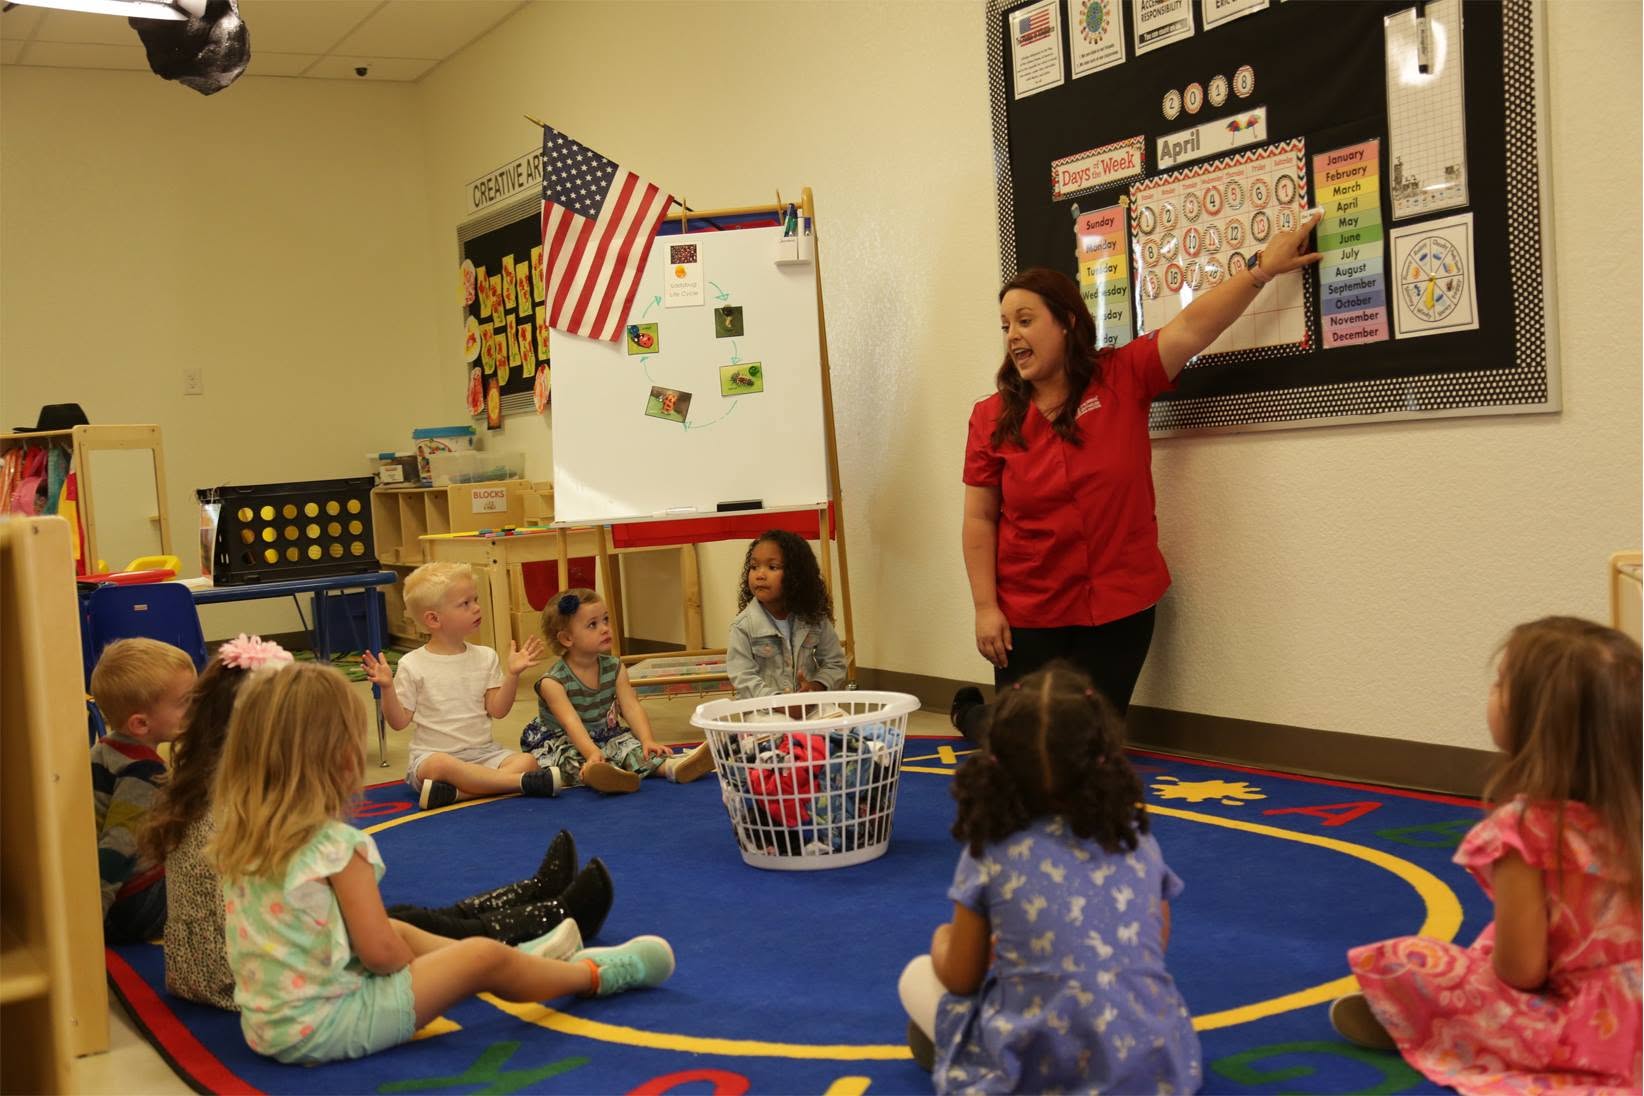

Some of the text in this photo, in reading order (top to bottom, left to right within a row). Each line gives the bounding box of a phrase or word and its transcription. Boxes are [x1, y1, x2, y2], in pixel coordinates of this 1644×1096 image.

[1141, 0, 1182, 22] RESPONSIBILITY
[1160, 129, 1200, 163] April
[1327, 149, 1364, 166] January
[1062, 166, 1091, 187] Days
[1101, 151, 1135, 175] Week
[1326, 165, 1367, 182] February
[473, 163, 524, 208] CREATIVE
[1333, 181, 1361, 197] March
[1165, 209, 1171, 223] 2
[1209, 194, 1216, 208] 4
[1231, 187, 1237, 201] 5
[1255, 187, 1262, 201] 6
[1281, 183, 1289, 198] 7
[1337, 197, 1358, 213] April
[1086, 215, 1115, 231] Sunday
[1338, 217, 1359, 228] May
[1148, 246, 1154, 259] 8
[1188, 235, 1196, 250] 10
[1230, 226, 1239, 241] 12
[1257, 219, 1265, 234] 13
[1281, 213, 1290, 228] 14
[1339, 233, 1361, 244] June
[1340, 248, 1359, 260] July
[1170, 271, 1178, 285] 16
[1335, 263, 1367, 277] August
[1328, 279, 1376, 295] September
[1335, 296, 1372, 309] October
[1330, 311, 1379, 326] November
[1332, 327, 1379, 342] December
[473, 490, 504, 500] BLOCKS
[1262, 801, 1384, 827] A
